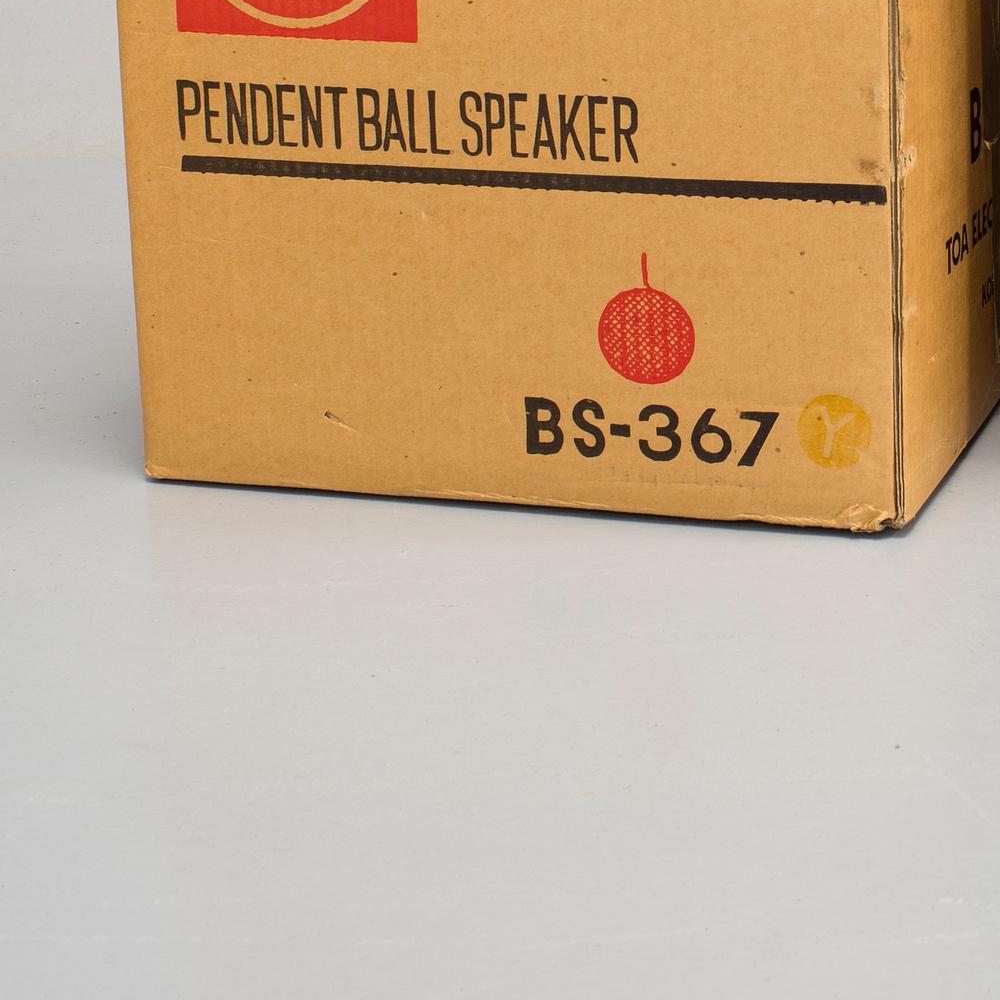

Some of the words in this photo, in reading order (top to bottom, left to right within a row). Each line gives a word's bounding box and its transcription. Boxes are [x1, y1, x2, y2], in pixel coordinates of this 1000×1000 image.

[176, 79, 348, 149] PENDENT
[356, 88, 452, 155] BALL
[459, 91, 639, 163] SPEAKER
[945, 223, 969, 275] TOA
[524, 396, 780, 467] BS-367
[817, 403, 856, 457] Y
